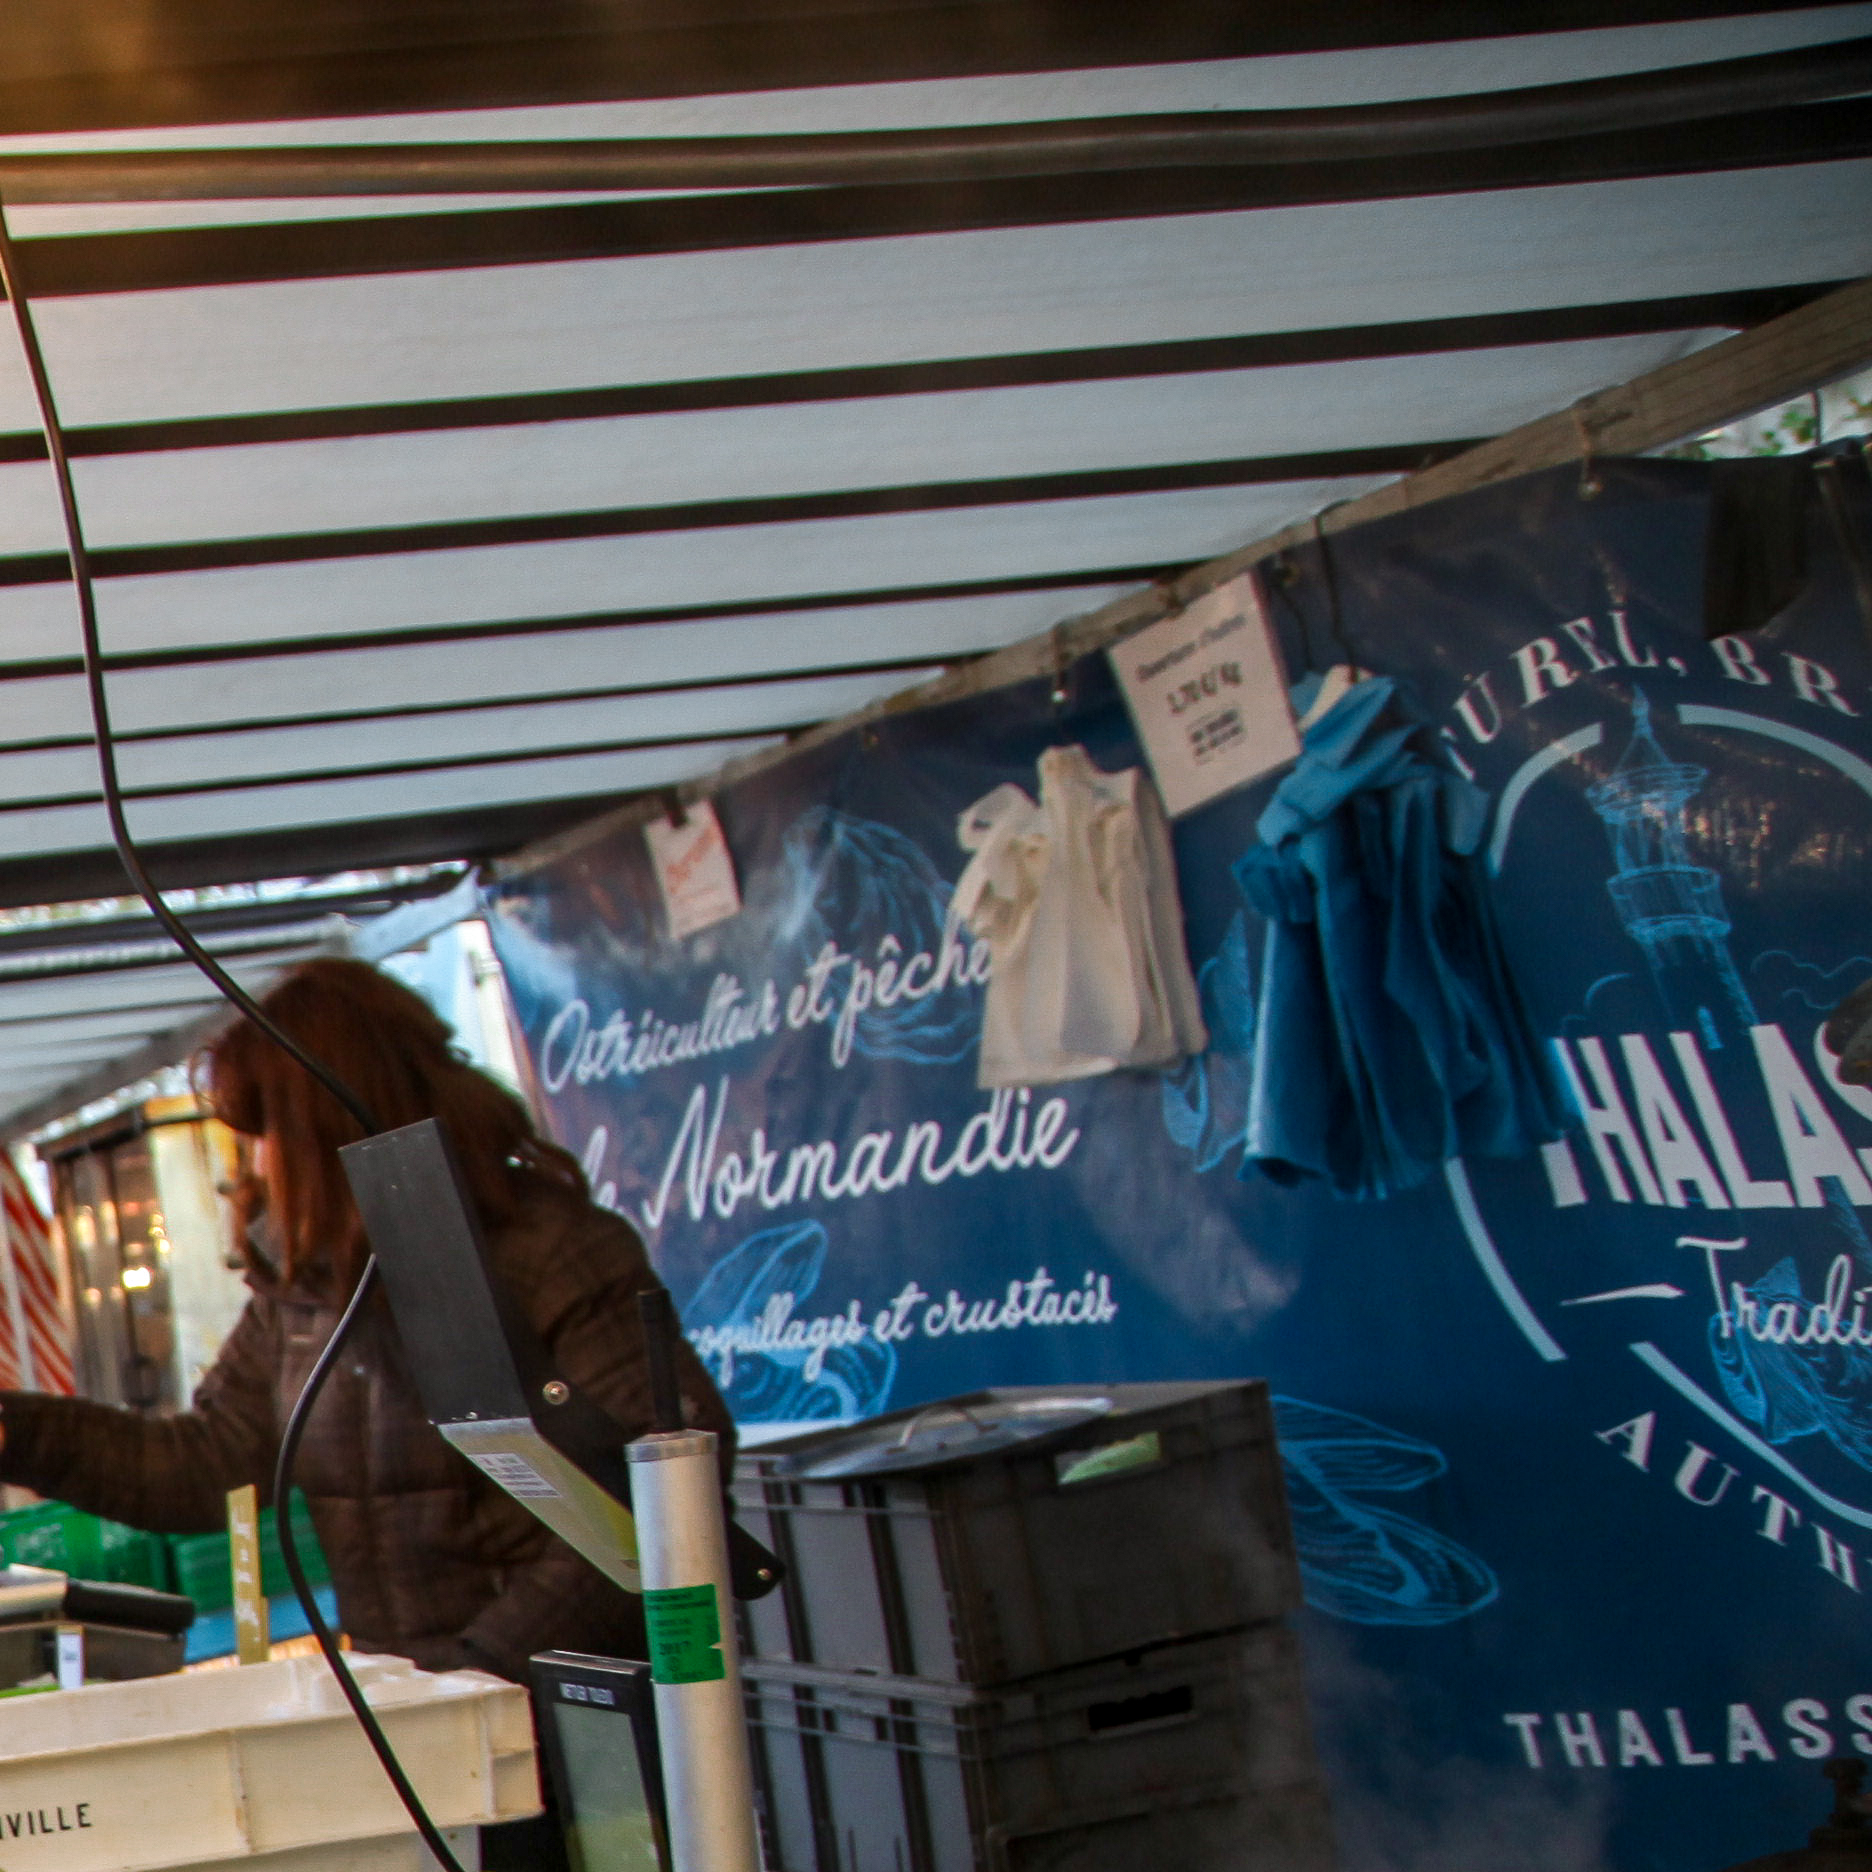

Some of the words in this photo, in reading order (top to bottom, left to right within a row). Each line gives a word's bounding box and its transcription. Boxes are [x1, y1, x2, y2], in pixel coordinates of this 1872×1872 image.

[1709, 633, 1872, 717] BR
[541, 972, 780, 1094] Ostréiculteur
[786, 940, 850, 1029] et
[830, 903, 994, 1068] pêche
[642, 1076, 1080, 1229] Normandie
[874, 1281, 929, 1343] et
[923, 1266, 1118, 1337] crustacés
[1593, 1410, 1872, 1592] AUTH
